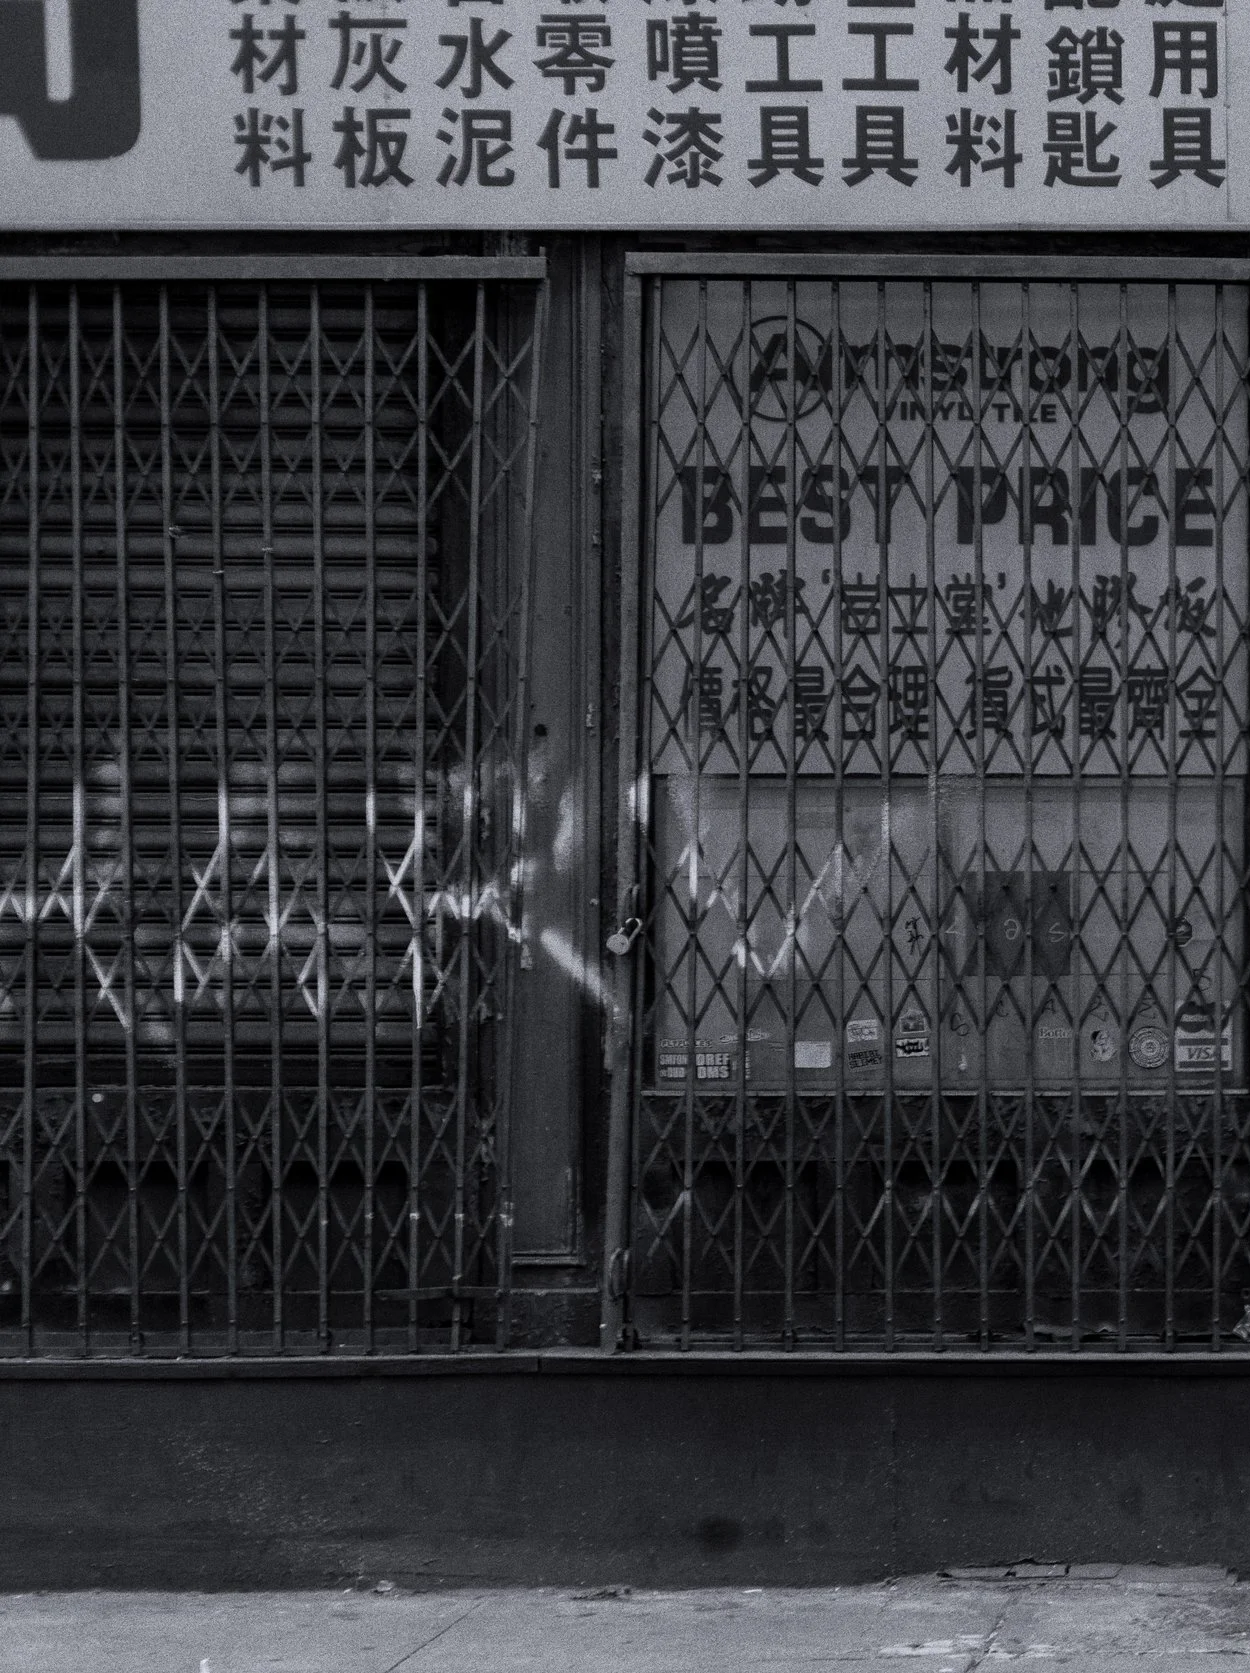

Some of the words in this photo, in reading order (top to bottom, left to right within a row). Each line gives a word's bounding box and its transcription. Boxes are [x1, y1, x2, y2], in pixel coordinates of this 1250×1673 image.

[231, 0, 312, 186] 材料
[330, 0, 414, 188] 灰板
[437, 0, 515, 187] 水泥
[536, 0, 618, 188] 零件
[643, 0, 723, 188] 噴漆
[746, 0, 824, 187] 工具
[842, 0, 919, 187] 工具
[945, 0, 1023, 188] 材料
[1043, 0, 1124, 187] 鎖匙
[1149, 0, 1226, 188] 用具
[748, 333, 1169, 414] Armstrong
[873, 401, 973, 421] VINYL
[992, 403, 1057, 423] TILE
[680, 465, 907, 545] BEST
[956, 465, 1213, 546] PRICE
